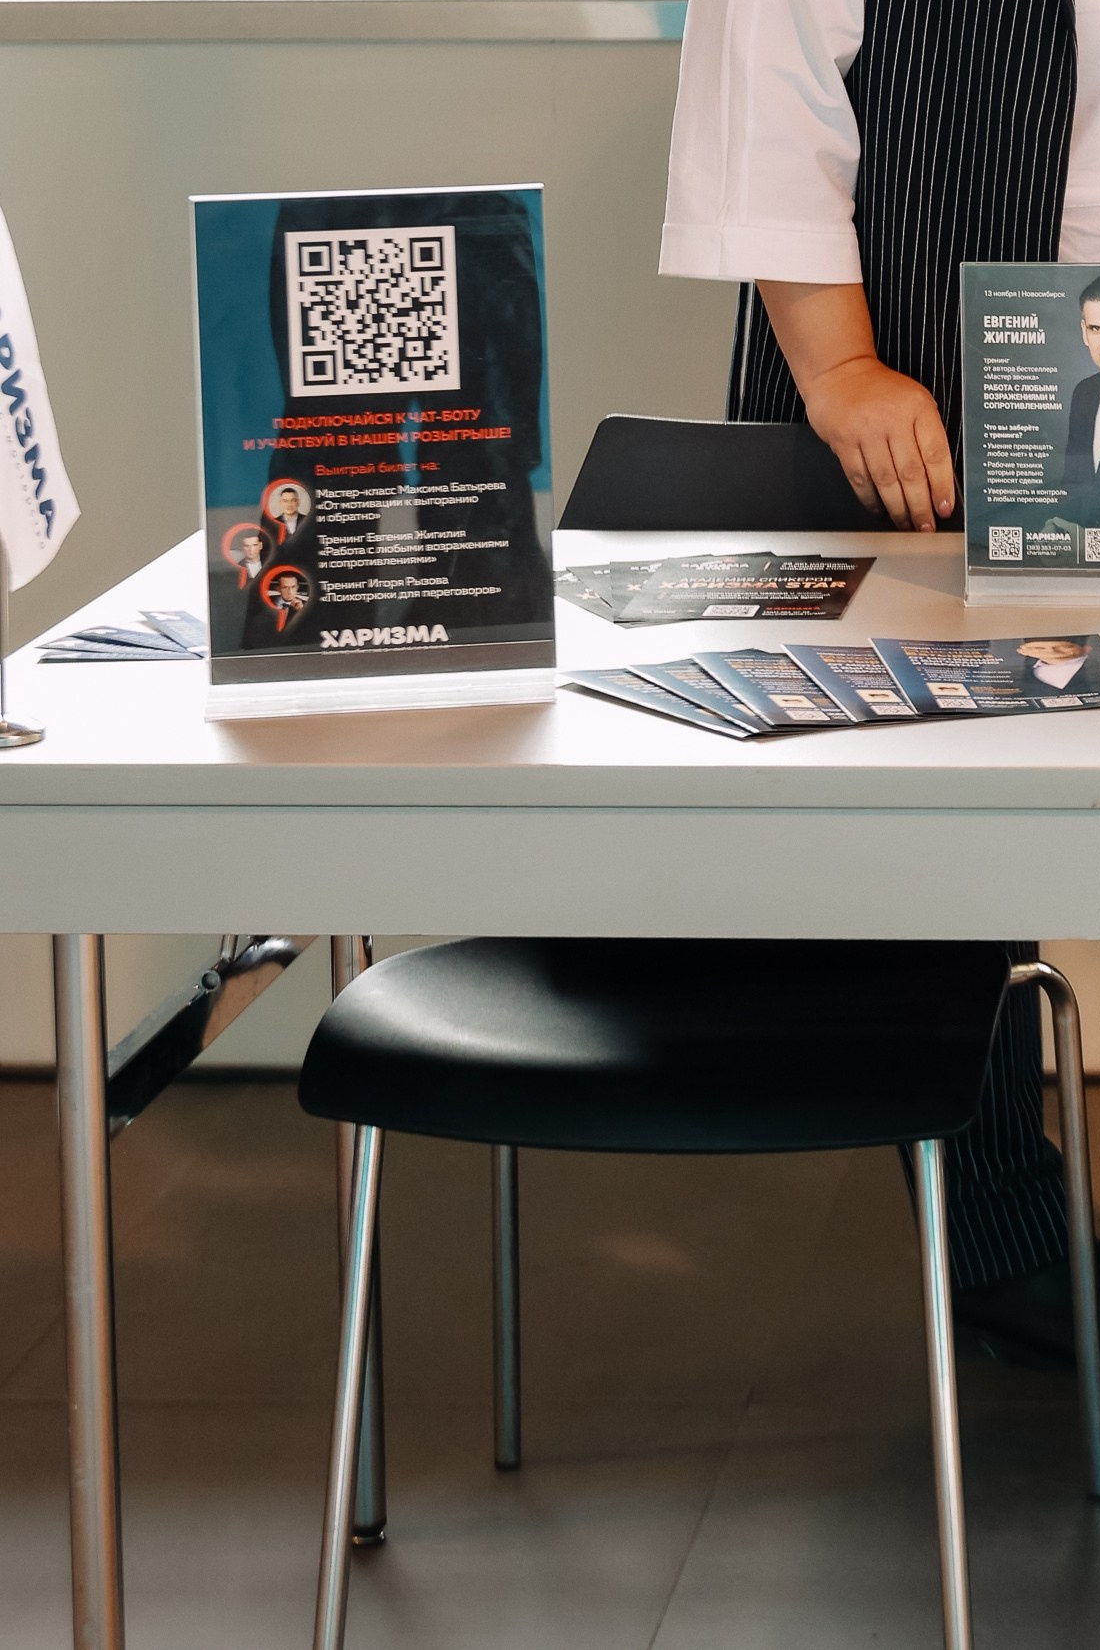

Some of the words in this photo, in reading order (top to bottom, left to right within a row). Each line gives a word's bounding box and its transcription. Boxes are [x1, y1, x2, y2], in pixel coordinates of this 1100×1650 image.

[993, 290, 1017, 298] ноября
[1022, 291, 1066, 300] Новосибирск
[984, 314, 1038, 328] ЕВГЕНИЙ
[984, 329, 1046, 344] ЖИГИЛИЙ
[1016, 366, 1058, 374] бестселлера
[984, 384, 1014, 392] РАБОТА
[1014, 384, 1020, 392] С
[1021, 384, 1058, 392] ЛЮБЫМИ
[984, 393, 1048, 401] ВОЗРАЖЕНИЯМИ
[984, 402, 1062, 410] СОПРОТИВЛЕНИЯМИ
[0, 307, 55, 540] РИЗМА
[272, 411, 393, 430] ПОДКЛЮЧАЙСЯ
[395, 412, 406, 424] К
[407, 409, 481, 423] ЧАТ-БОТУ
[243, 439, 256, 450] И
[257, 433, 336, 450] УЧАСТВУЙ
[337, 435, 348, 446] В
[350, 432, 408, 445] НАШЕМ
[412, 427, 512, 442] РОЗЫГРЫШЕ!
[989, 432, 1023, 440] тренинга?
[314, 463, 375, 476] Выиграй
[378, 462, 418, 472] билет
[315, 487, 396, 499] Мастер-класс
[397, 485, 449, 495] Максима
[450, 482, 506, 493] Батырева
[316, 500, 340, 510] «От
[342, 498, 402, 509] мотивации
[414, 496, 480, 507] выгоранию
[318, 534, 366, 546] Тренинг
[366, 532, 414, 542] Евгения
[414, 530, 466, 540] Жигилия
[1026, 532, 1072, 542] ХАРИЗМА
[318, 546, 366, 556] «Работа
[376, 544, 424, 554] любыми
[425, 540, 510, 552] возражениями
[318, 580, 367, 592] Тренинг
[367, 578, 404, 589] Игоря
[405, 576, 449, 586] Рызова
[320, 592, 397, 602] «Психотрюки
[398, 590, 420, 600] для
[422, 586, 502, 598] переговоров»
[320, 624, 449, 648] ХАРИЗМА
